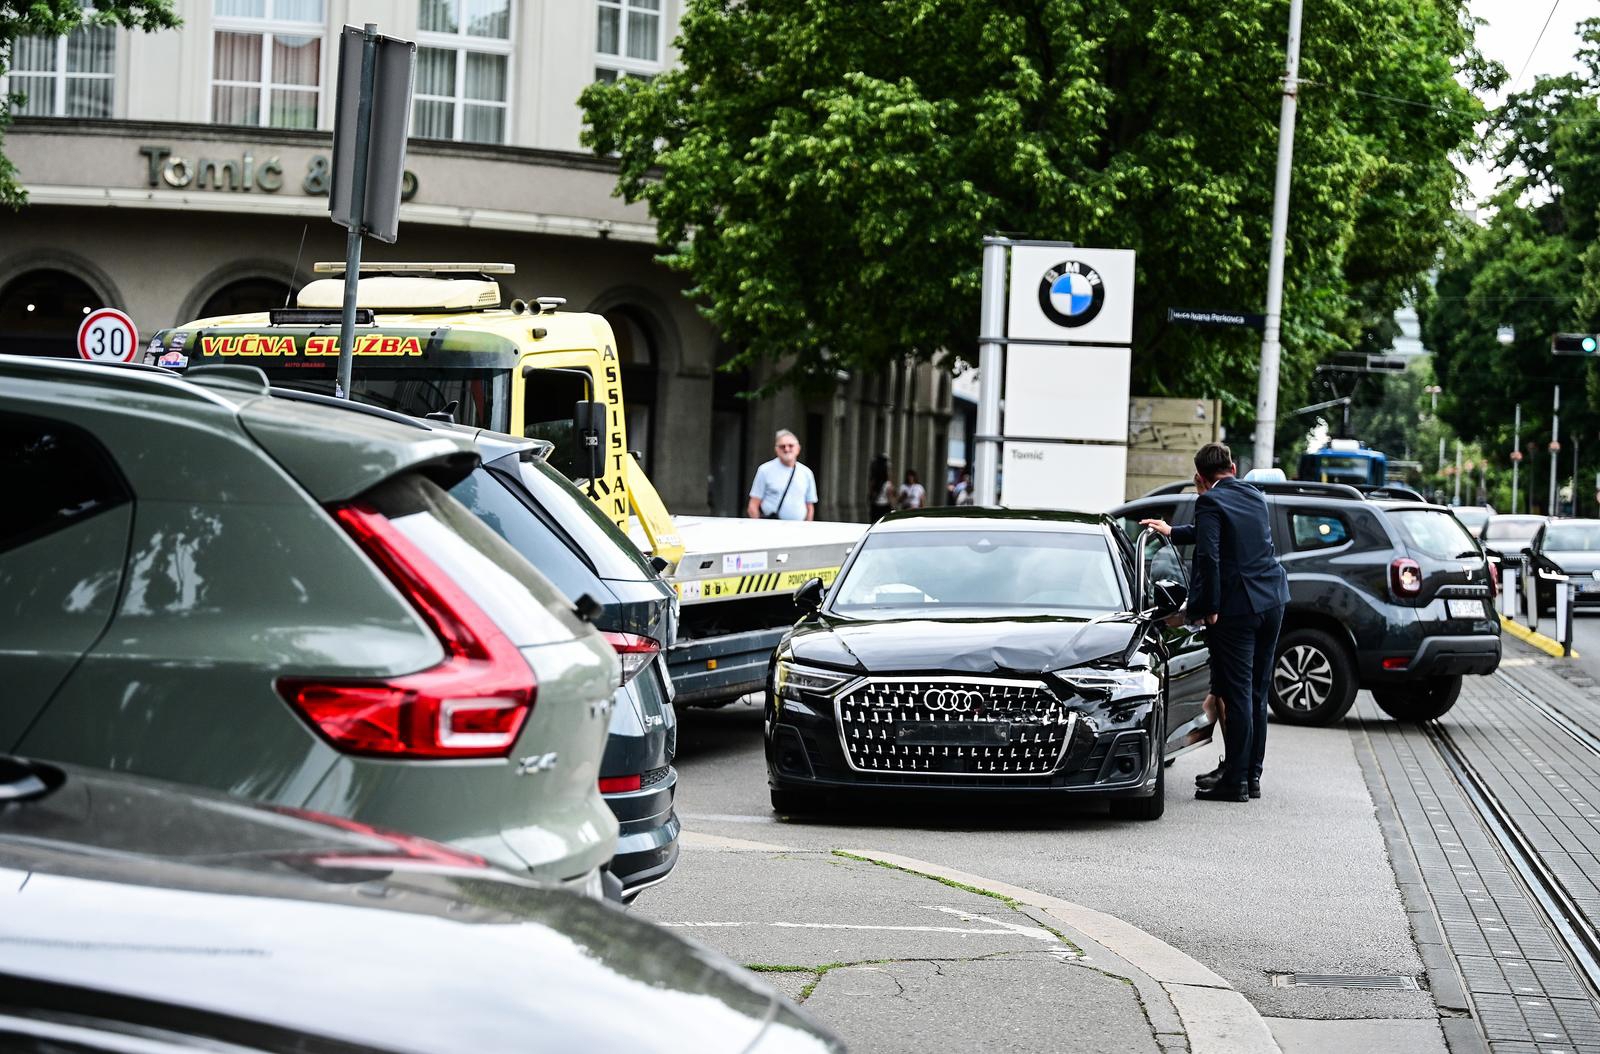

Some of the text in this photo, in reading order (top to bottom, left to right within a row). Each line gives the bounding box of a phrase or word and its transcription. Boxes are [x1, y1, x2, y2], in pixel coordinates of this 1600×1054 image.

[140, 146, 282, 192] Tomić
[303, 155, 330, 196] &
[1045, 261, 1101, 286] BMW
[92, 327, 124, 356] 30
[202, 334, 297, 357] VUČNA
